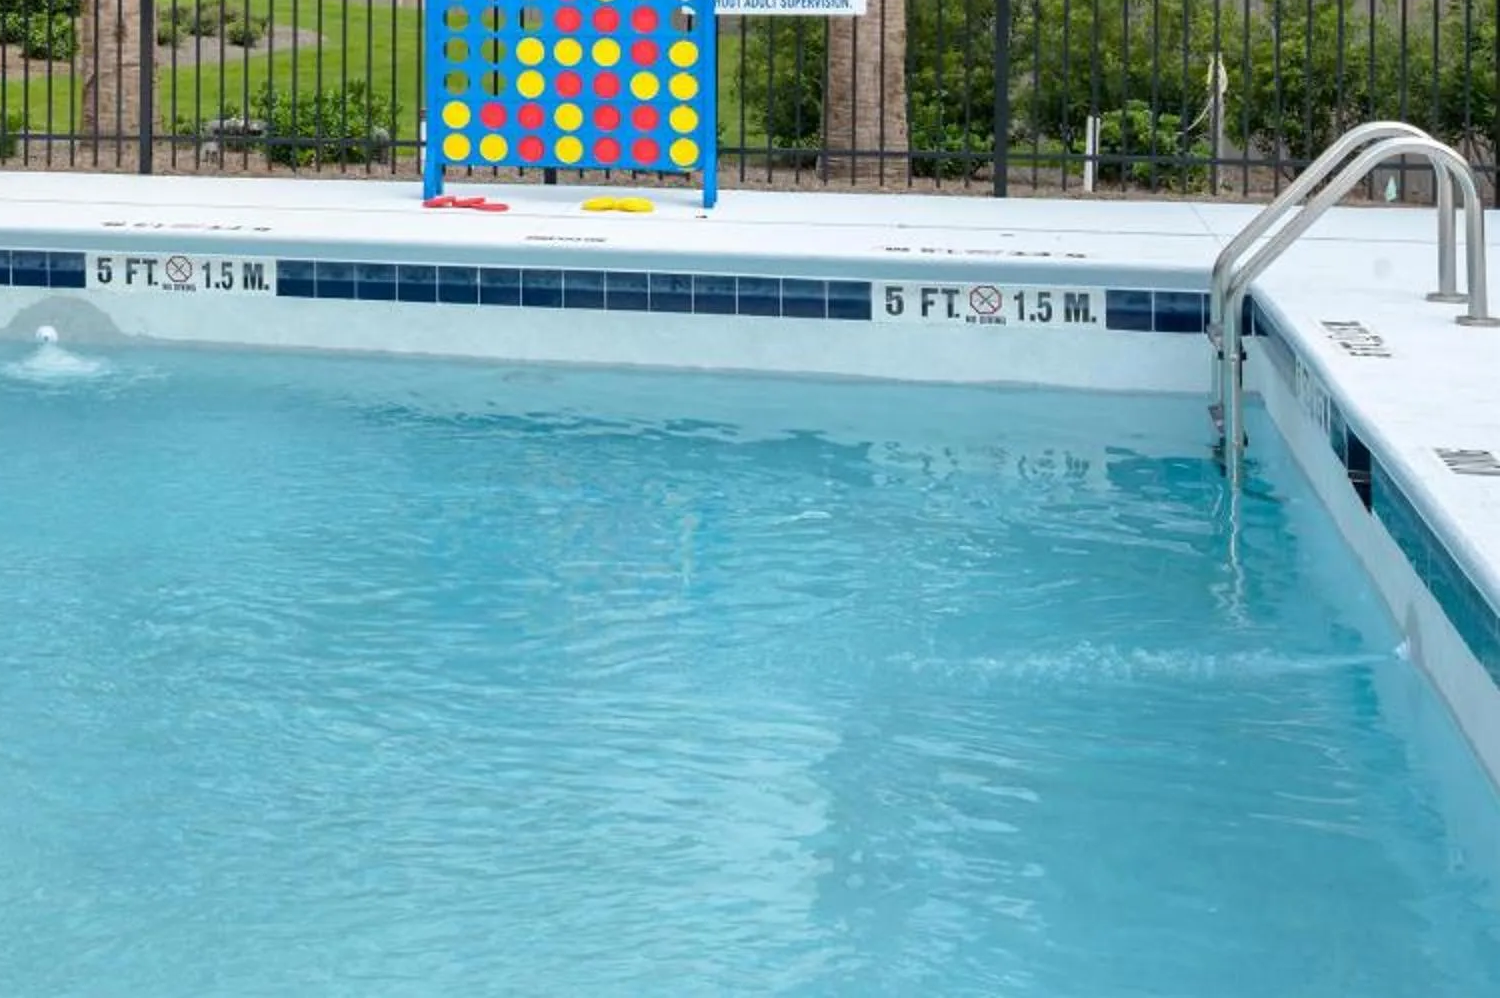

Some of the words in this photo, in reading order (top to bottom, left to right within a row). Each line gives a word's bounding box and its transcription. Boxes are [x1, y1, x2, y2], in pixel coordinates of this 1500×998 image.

[97, 257, 113, 284] 5
[125, 258, 159, 287] FT.
[202, 261, 234, 290] 1.5
[242, 263, 270, 291] M.
[885, 285, 905, 316] 5
[920, 287, 961, 319] FT.
[1013, 290, 1053, 322] 1.5
[1063, 292, 1097, 323] M.
